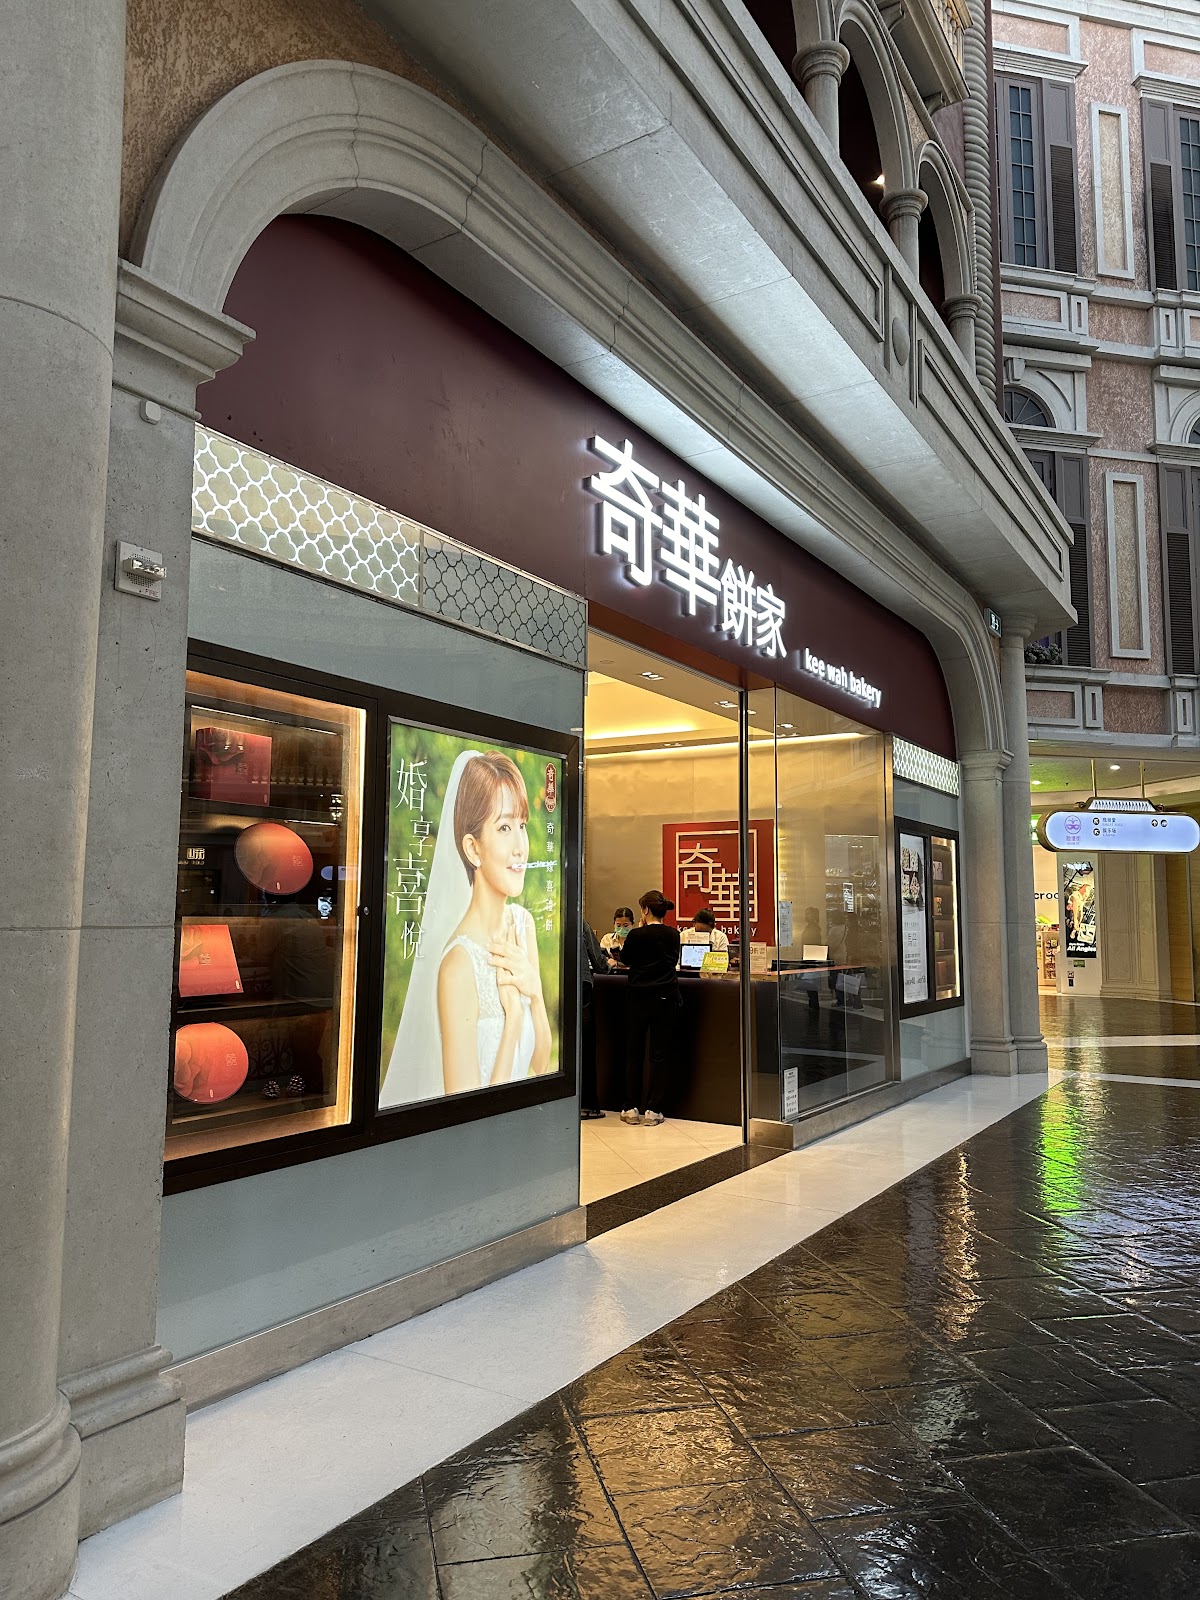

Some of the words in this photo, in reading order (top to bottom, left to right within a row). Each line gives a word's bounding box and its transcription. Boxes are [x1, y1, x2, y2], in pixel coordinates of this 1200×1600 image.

[589, 434, 787, 658] 奇華餅家
[805, 647, 826, 677] kee
[827, 664, 848, 688] wah
[849, 670, 882, 709] bakery
[721, 925, 757, 937] baky
